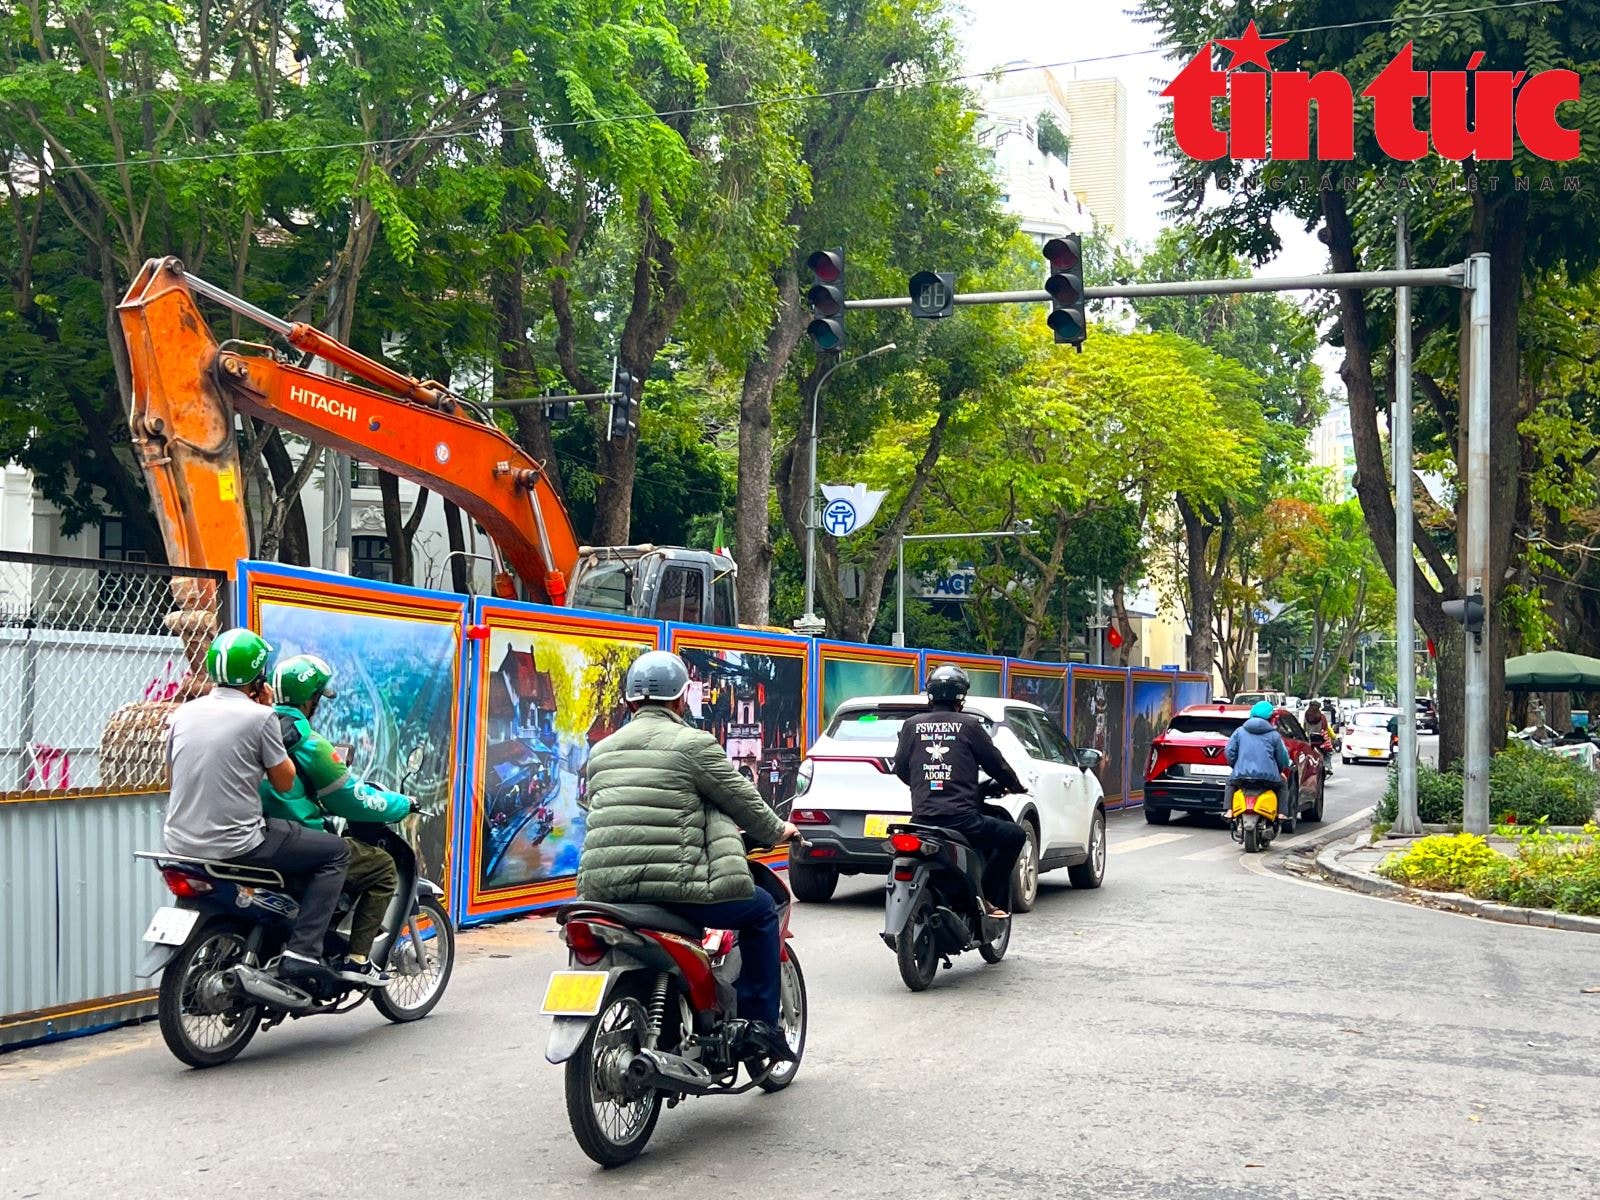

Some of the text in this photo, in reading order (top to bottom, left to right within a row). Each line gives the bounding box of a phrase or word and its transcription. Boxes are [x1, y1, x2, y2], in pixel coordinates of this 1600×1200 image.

[290, 385, 357, 422] HITACHI
[915, 722, 962, 733] FSWXENV
[924, 771, 951, 780] ADORE
